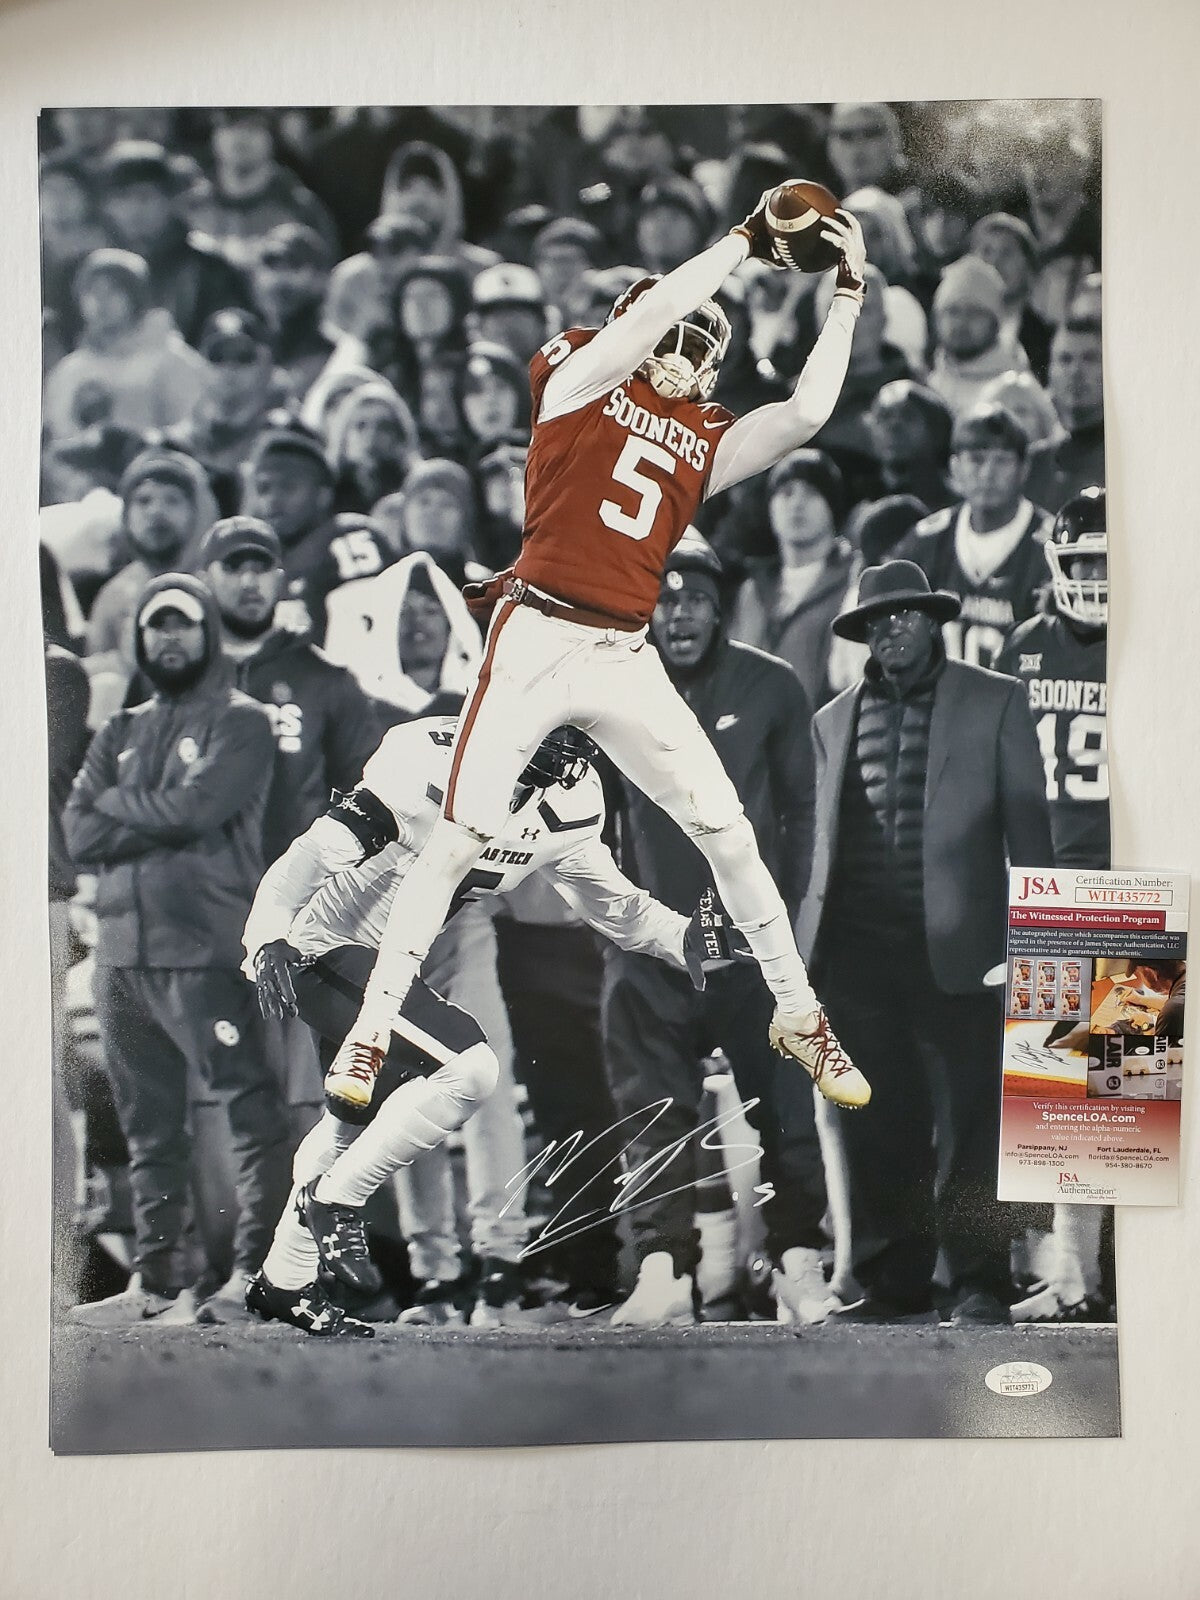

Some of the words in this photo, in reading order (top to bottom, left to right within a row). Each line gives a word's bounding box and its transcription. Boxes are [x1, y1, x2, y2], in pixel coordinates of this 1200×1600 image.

[539, 332, 571, 365] 5
[603, 387, 710, 471] SOONERS
[599, 434, 676, 540] 5
[330, 529, 382, 579] 15
[1036, 713, 1109, 800] 19
[499, 850, 533, 865] TECH
[1018, 877, 1061, 900] JSA
[1076, 876, 1131, 886] Certification
[1135, 878, 1173, 887] Number:
[1089, 890, 1161, 903] WIT435772
[1011, 911, 1027, 920] The
[1029, 912, 1073, 922] Witnessed
[1076, 913, 1120, 923] Protection
[1123, 915, 1160, 925] Program
[1033, 1102, 1053, 1111] Verify
[1069, 1103, 1109, 1111] certification
[1111, 1105, 1119, 1113] by
[1121, 1105, 1145, 1114] visiting
[1042, 1112, 1136, 1123] SpenceLOA.com
[1050, 1124, 1078, 1132] entering
[1091, 1125, 1141, 1133] alpha-numeric
[1017, 1144, 1057, 1152] Parsippany,
[1057, 1172, 1079, 1184] JSA
